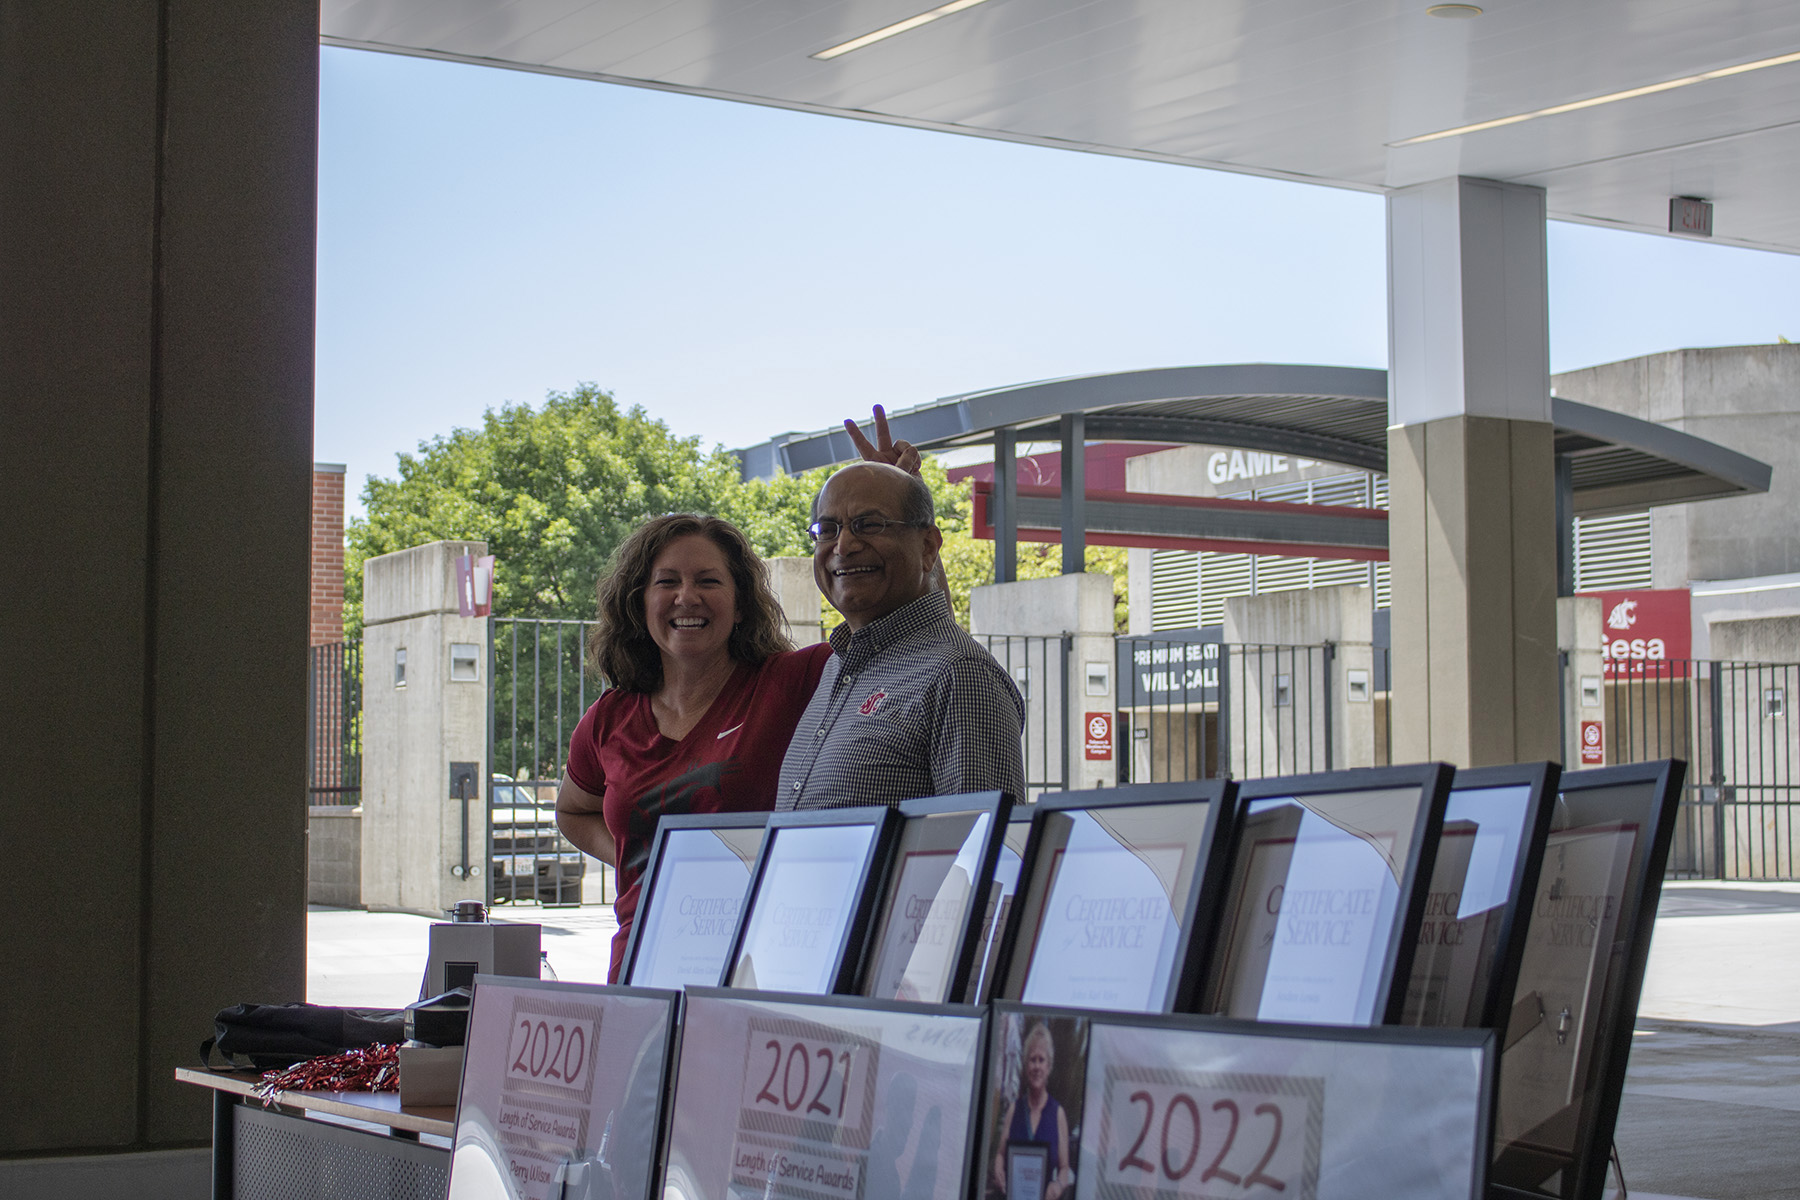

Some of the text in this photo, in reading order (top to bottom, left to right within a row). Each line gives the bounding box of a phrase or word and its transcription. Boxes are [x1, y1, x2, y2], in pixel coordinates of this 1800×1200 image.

[1207, 450, 1289, 484] GAME
[1186, 643, 1219, 662] SEATI
[1141, 671, 1180, 692] WILL
[679, 894, 743, 916] CERTIFICA
[1065, 893, 1163, 921] CERTIFICATE
[1080, 920, 1147, 949] SERVICE
[1283, 915, 1354, 946] SERVICE
[1420, 921, 1466, 945] RVICE
[512, 1019, 585, 1084] 2020
[755, 1039, 852, 1119] 2021
[499, 1107, 577, 1140] Length of Service Awards
[1119, 1090, 1285, 1192] 2022
[510, 1160, 529, 1184] Perry
[735, 1147, 766, 1175] Length
[779, 1156, 814, 1182] Service
[816, 1164, 855, 1191] Awards
